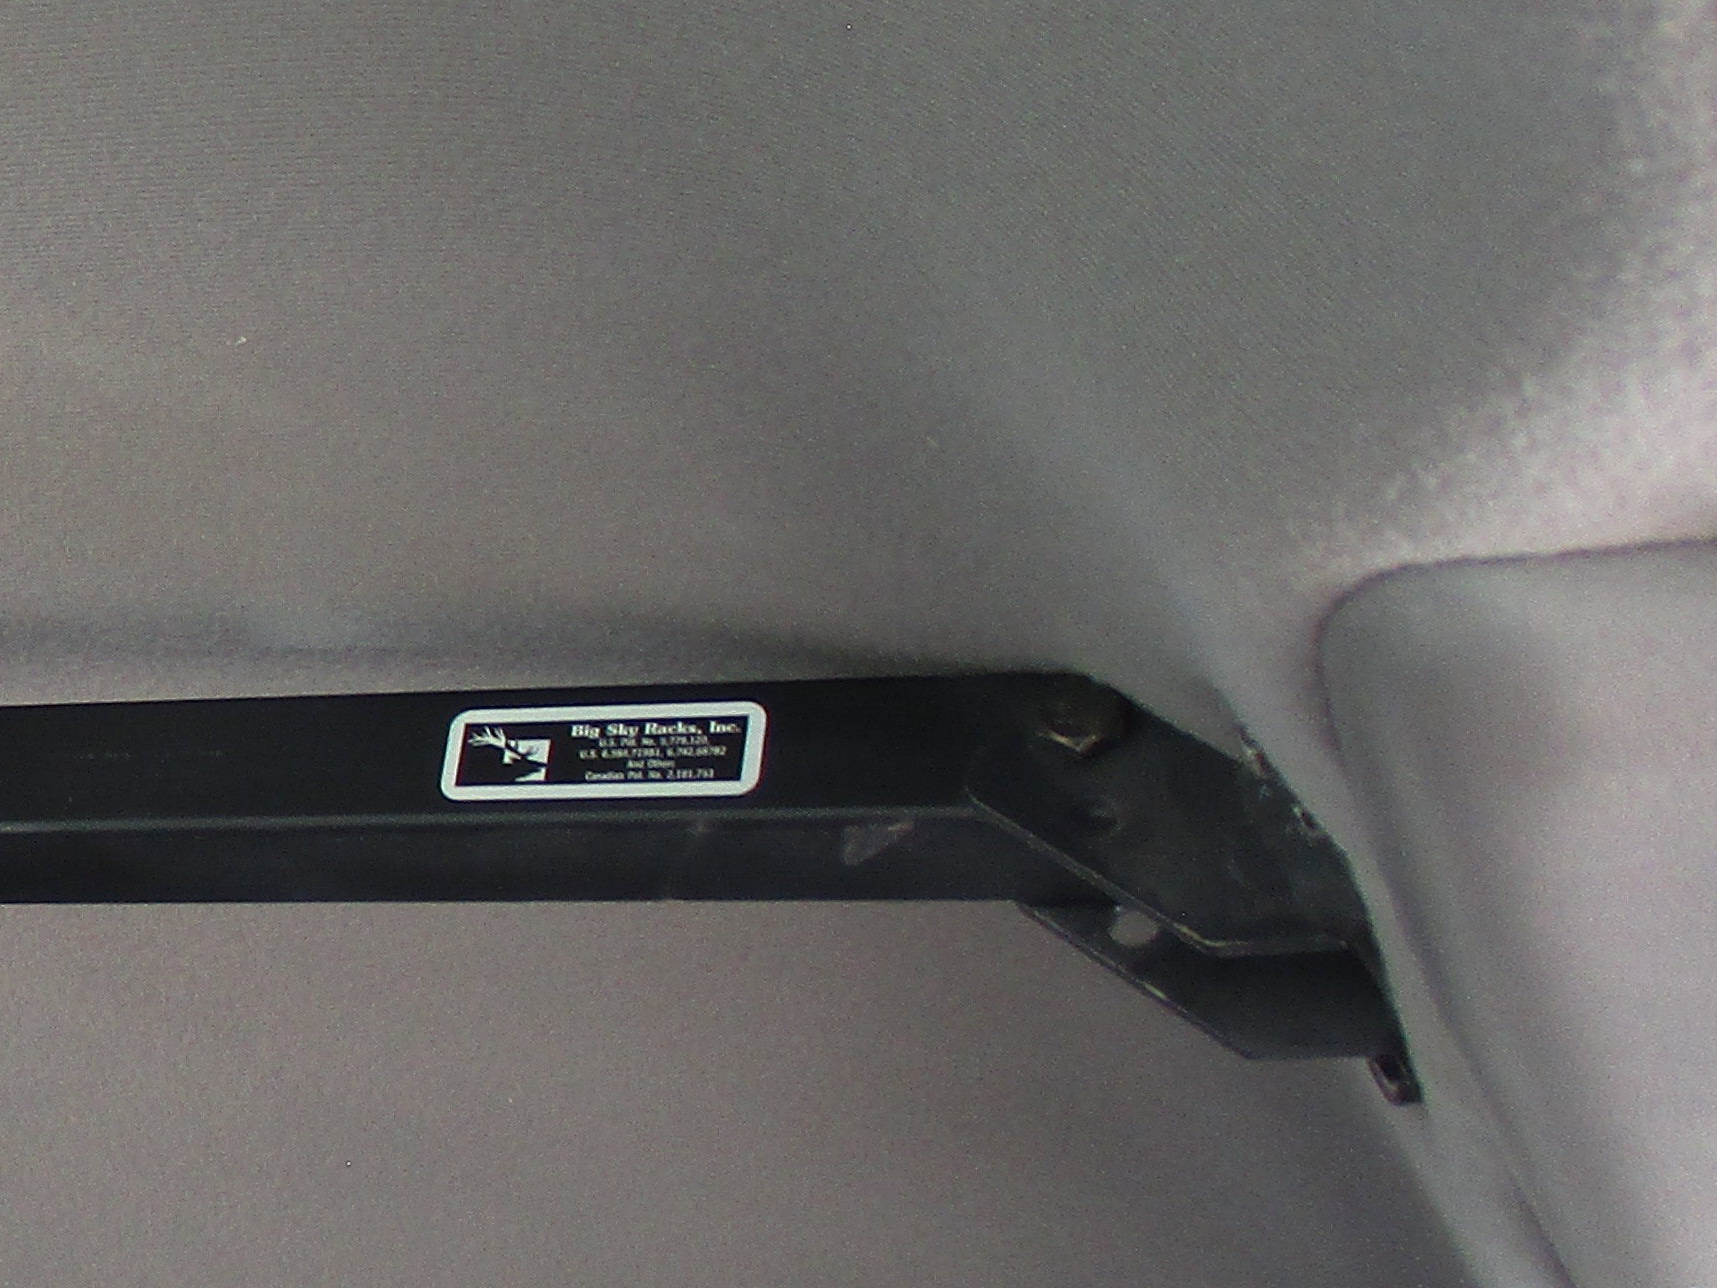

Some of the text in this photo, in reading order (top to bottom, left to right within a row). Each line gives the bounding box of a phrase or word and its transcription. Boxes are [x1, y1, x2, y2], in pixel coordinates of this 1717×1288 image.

[571, 720, 742, 740] Big Sky Racks, Inc.
